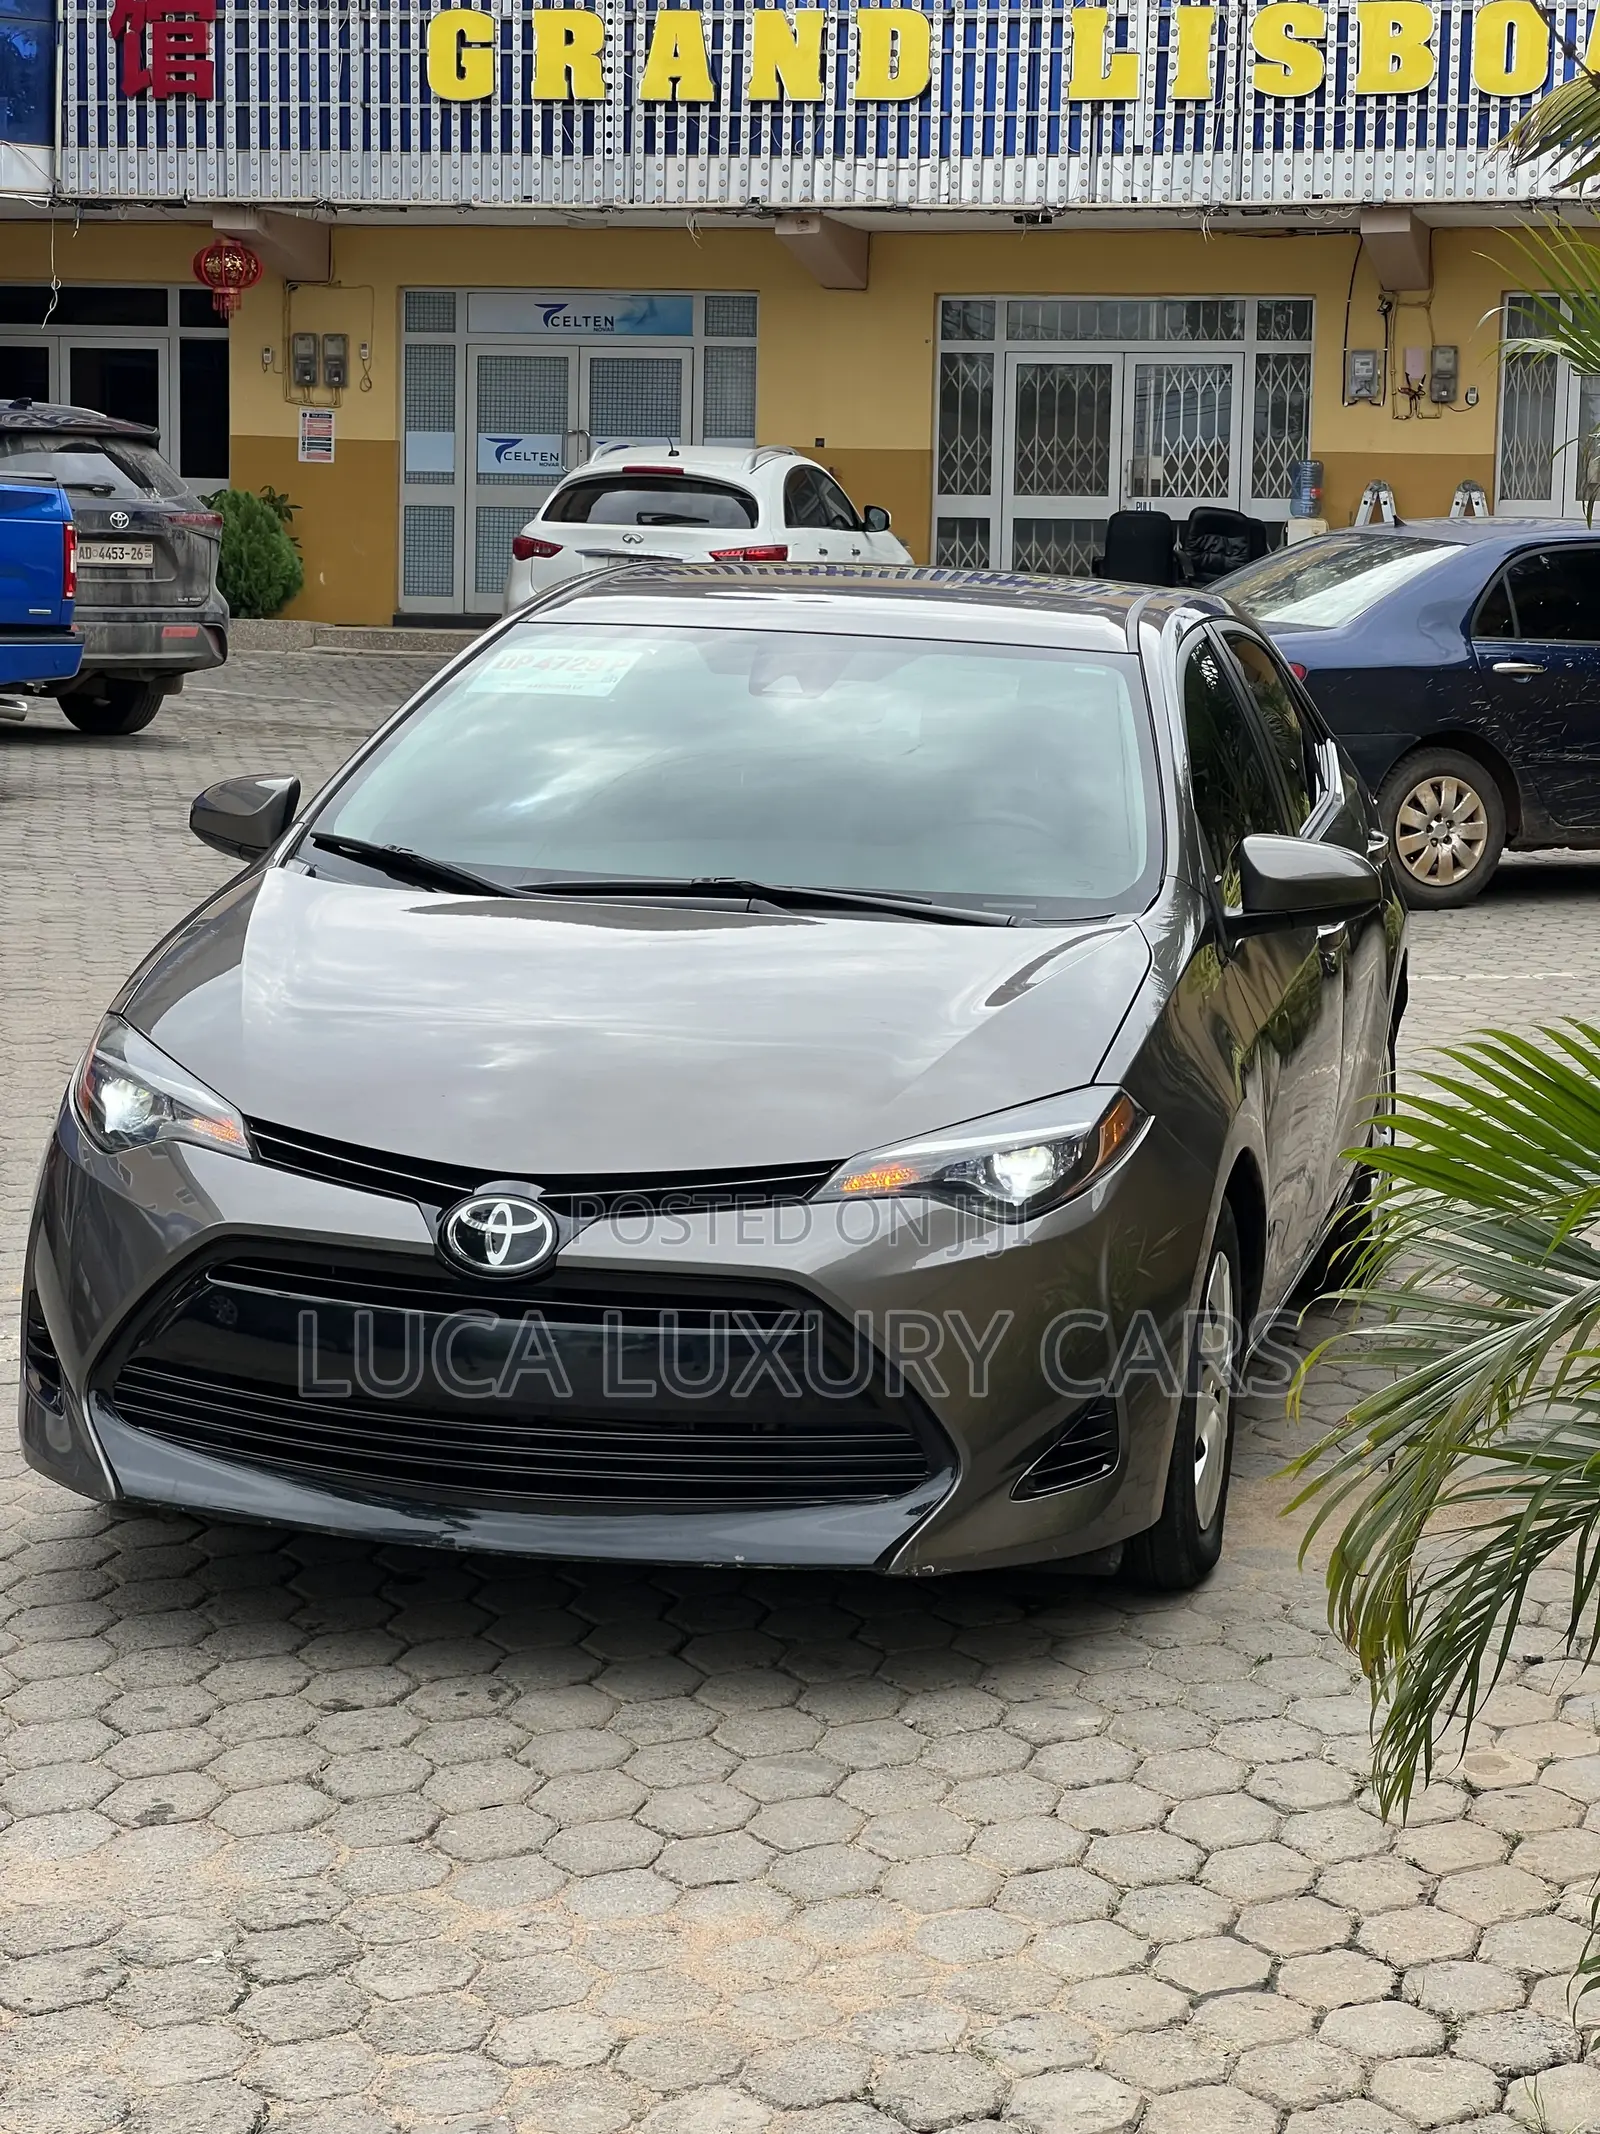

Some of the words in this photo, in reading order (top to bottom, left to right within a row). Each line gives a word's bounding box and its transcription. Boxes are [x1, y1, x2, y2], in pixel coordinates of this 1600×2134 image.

[427, 8, 932, 103] GRAND
[550, 315, 614, 328] CELTEN
[503, 451, 559, 462] CELTEN
[98, 546, 143, 560] 4453-26
